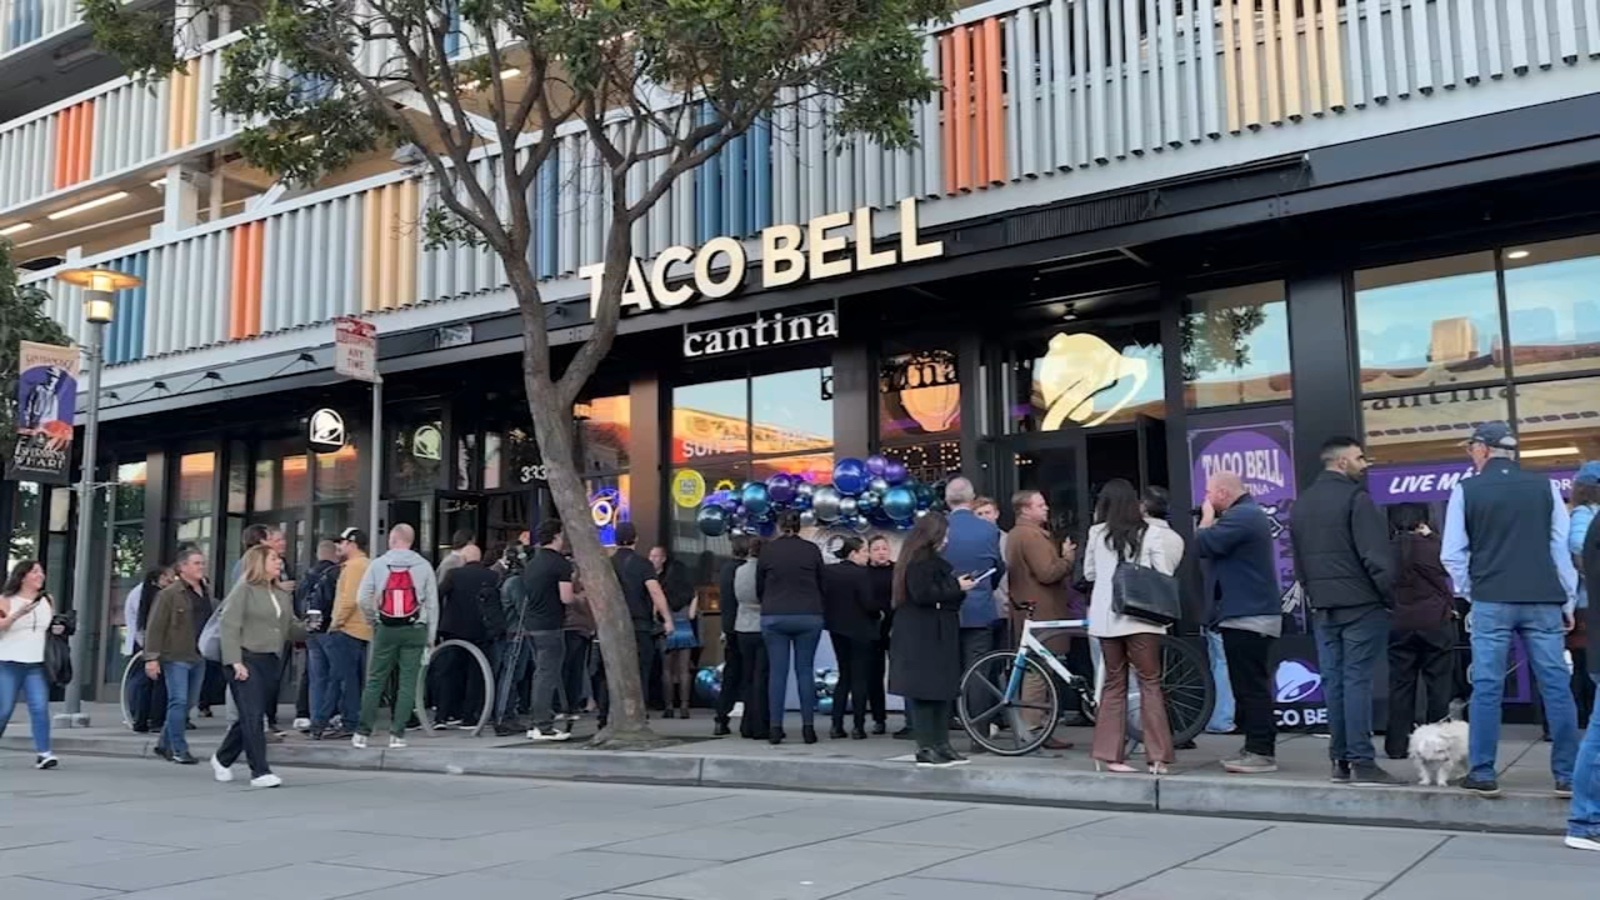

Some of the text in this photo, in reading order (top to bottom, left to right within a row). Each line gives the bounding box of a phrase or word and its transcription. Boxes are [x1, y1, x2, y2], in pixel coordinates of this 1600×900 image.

[579, 197, 943, 319] TACO BELL
[684, 311, 838, 357] cantina
[1244, 449, 1284, 488] BELL
[1389, 474, 1436, 494] LIVE
[1273, 708, 1328, 727] CO BE
